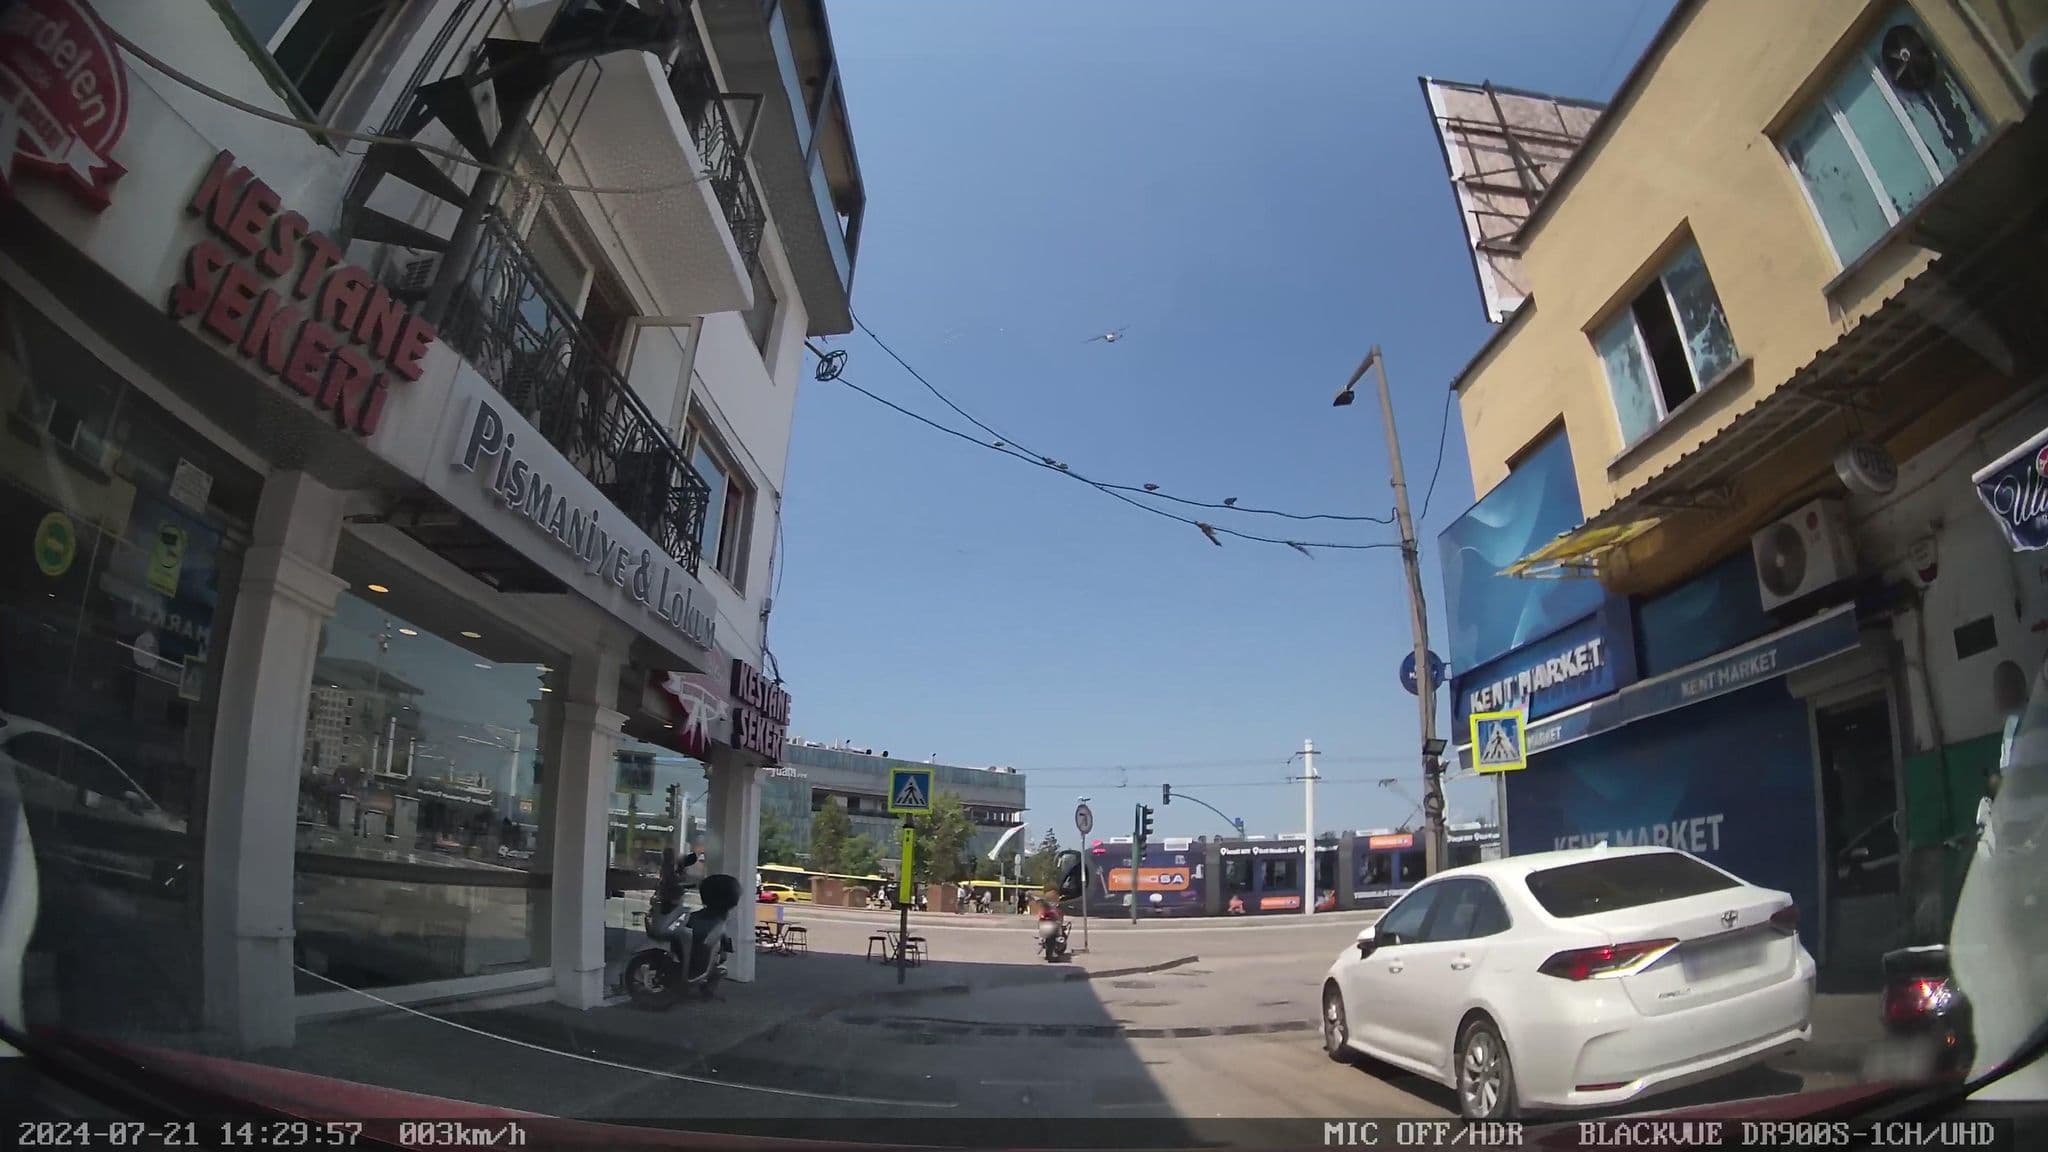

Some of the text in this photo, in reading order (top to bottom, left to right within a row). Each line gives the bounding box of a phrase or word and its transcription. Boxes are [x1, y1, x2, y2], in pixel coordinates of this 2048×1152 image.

[188, 148, 437, 381] KESTANE
[632, 549, 651, 606] &
[734, 660, 792, 726] KESTANE
[1470, 638, 1604, 713] KENT MARKET
[1718, 649, 1777, 686] MARKET
